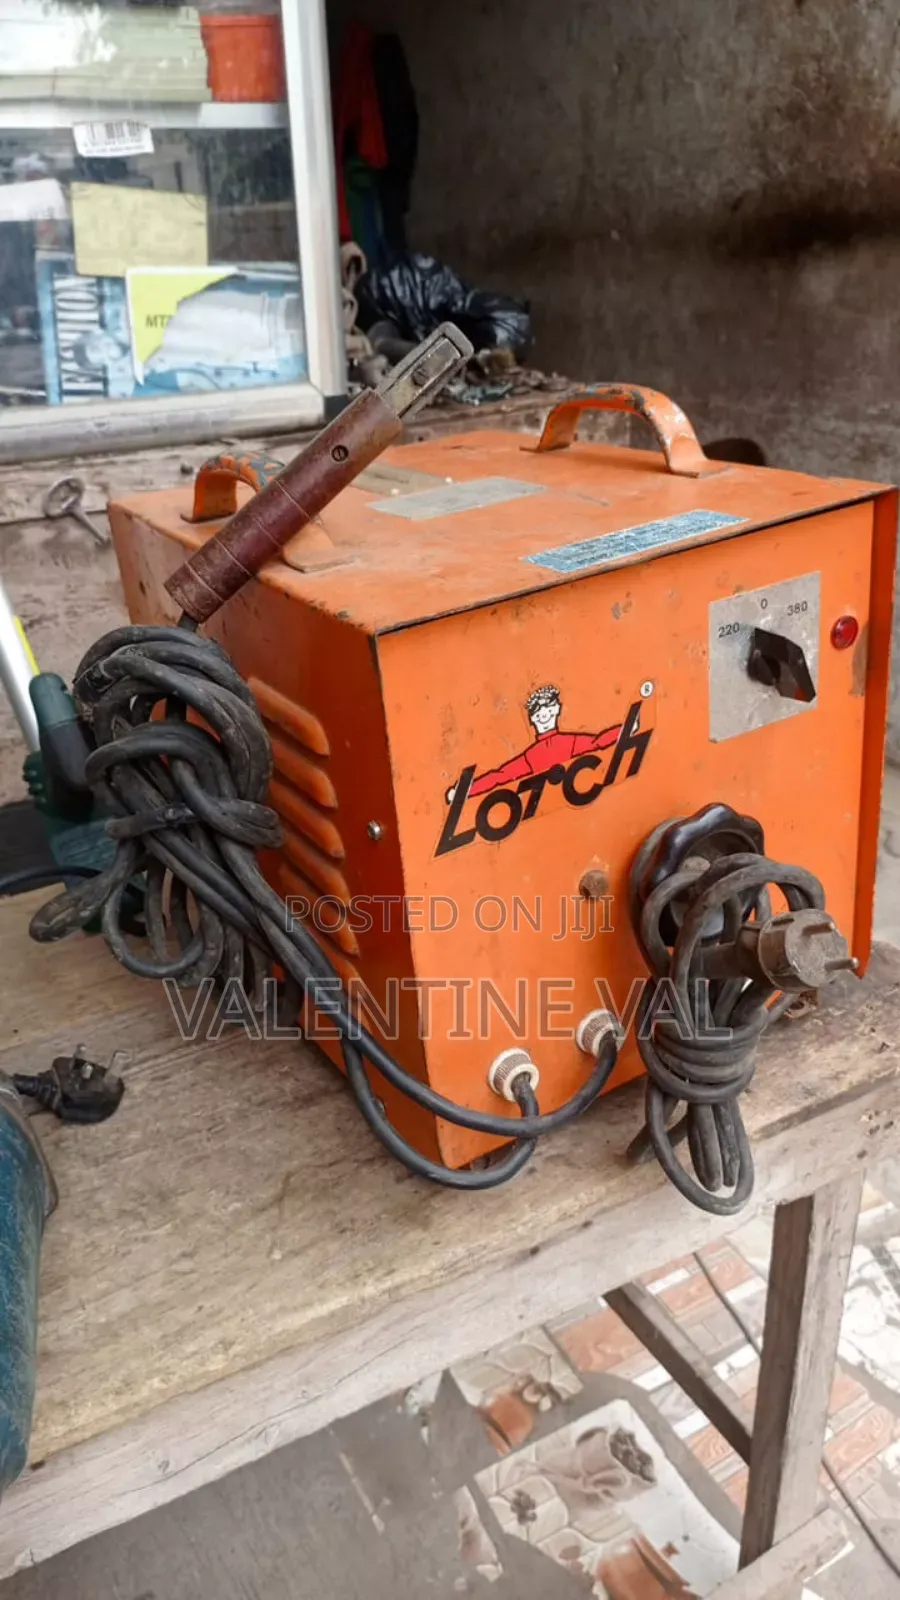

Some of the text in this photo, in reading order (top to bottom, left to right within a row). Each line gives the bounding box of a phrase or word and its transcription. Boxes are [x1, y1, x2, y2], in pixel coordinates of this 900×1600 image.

[145, 314, 173, 329] MT
[53, 273, 105, 391] FAHION
[760, 598, 768, 610] 0
[787, 601, 807, 616] 380
[718, 622, 740, 638] 220
